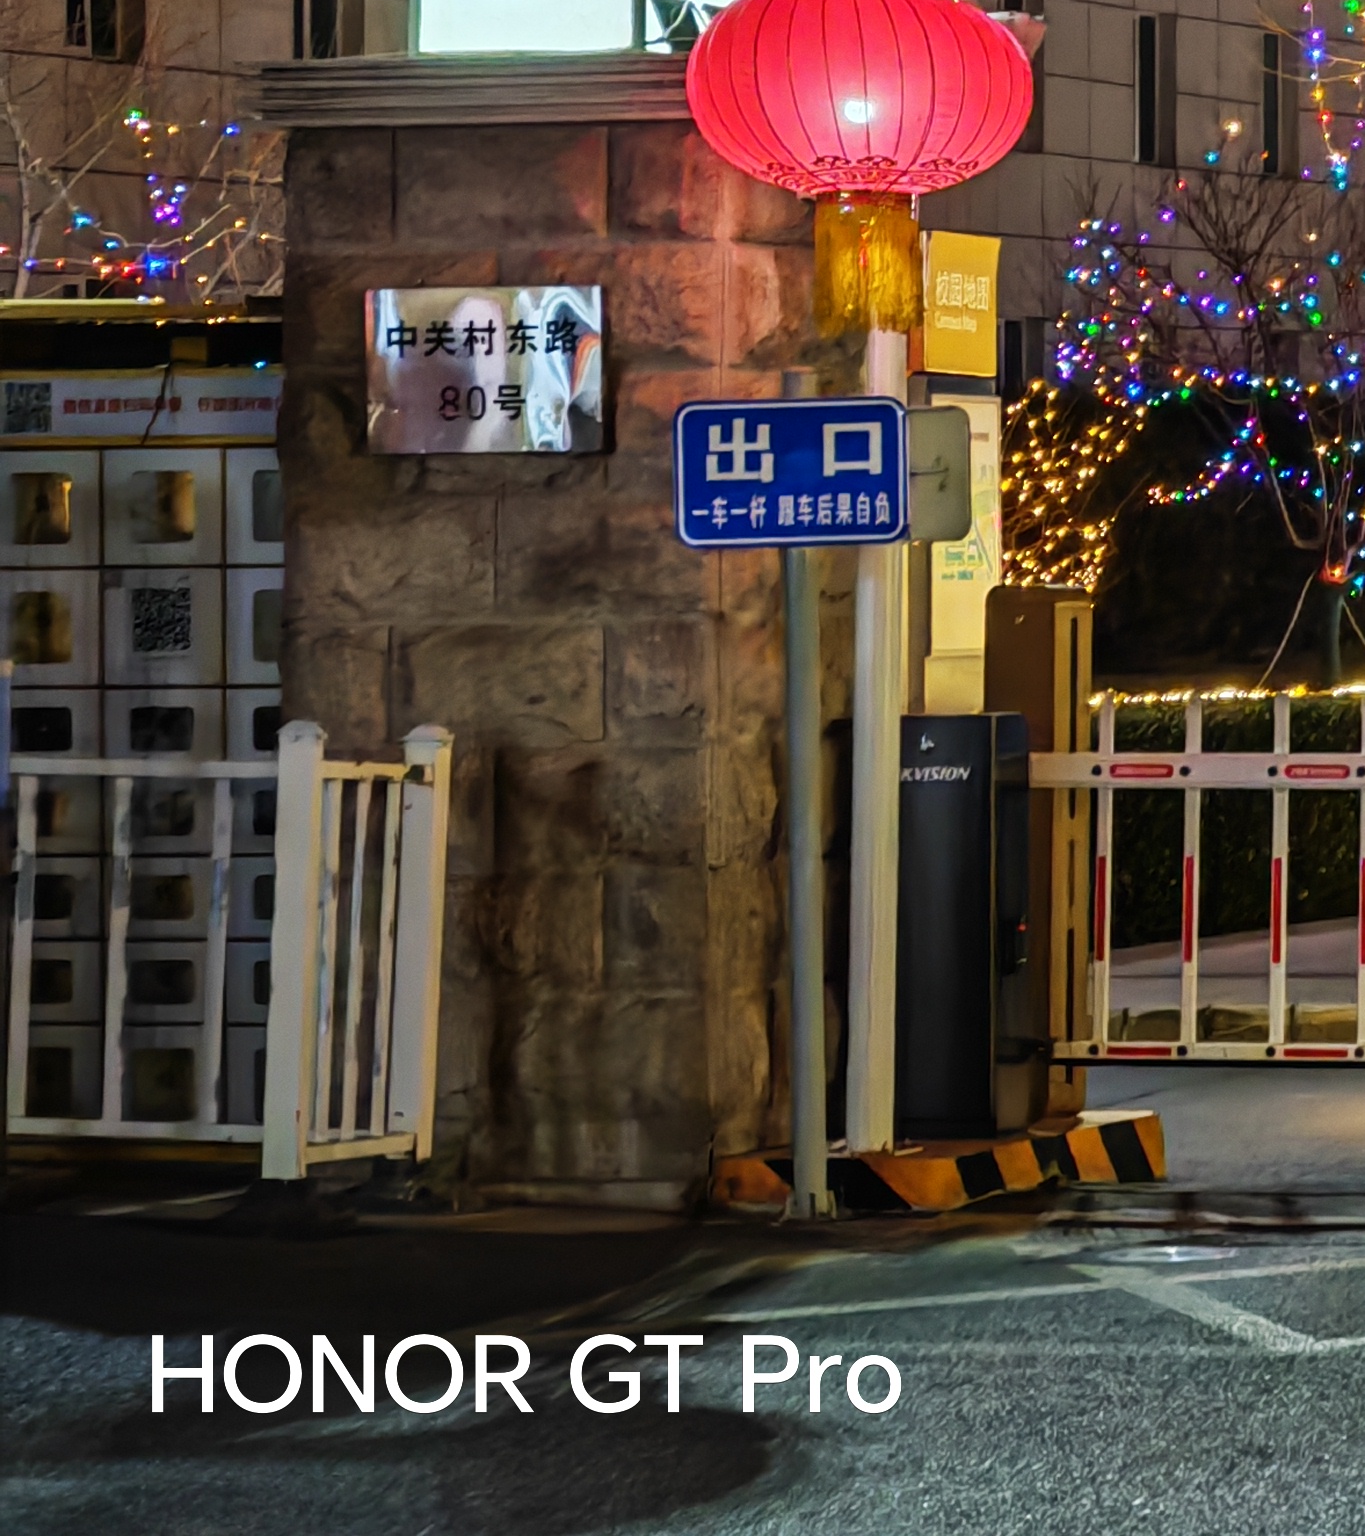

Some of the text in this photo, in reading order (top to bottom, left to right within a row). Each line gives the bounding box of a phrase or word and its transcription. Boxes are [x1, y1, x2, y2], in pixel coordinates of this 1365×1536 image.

[386, 319, 579, 358] 中关村东路
[438, 384, 527, 421] 80号
[692, 491, 891, 530] 一车一杆 跟车后果自负
